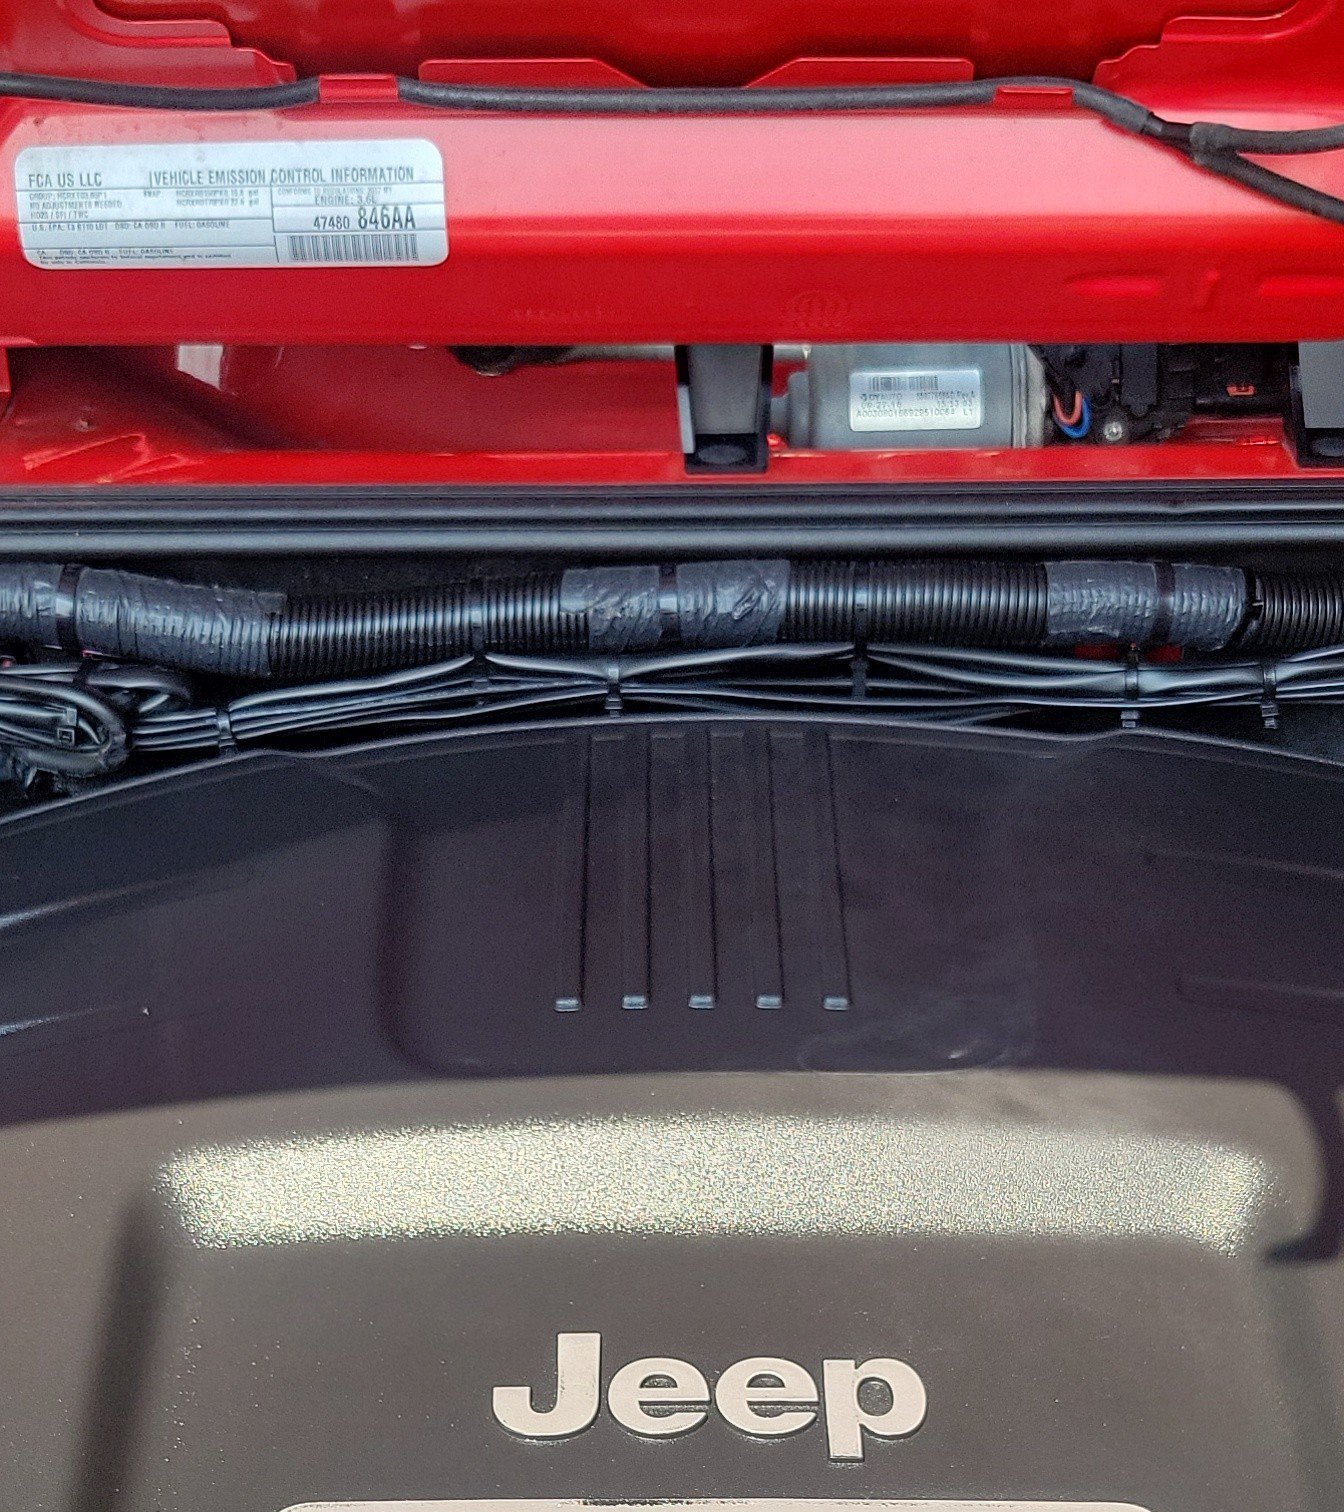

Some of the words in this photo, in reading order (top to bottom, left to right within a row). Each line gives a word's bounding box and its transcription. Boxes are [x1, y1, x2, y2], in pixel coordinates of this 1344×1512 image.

[28, 173, 52, 188] FCA
[57, 172, 75, 188] US
[79, 171, 103, 187] LLC
[153, 169, 204, 186] VEHICLE
[208, 168, 266, 186] EMISSION
[271, 167, 326, 184] CONTROL
[331, 166, 414, 183] INFORMATION
[313, 216, 351, 230] 47480
[357, 205, 417, 230] 846AA
[491, 1331, 929, 1463] Jeep
